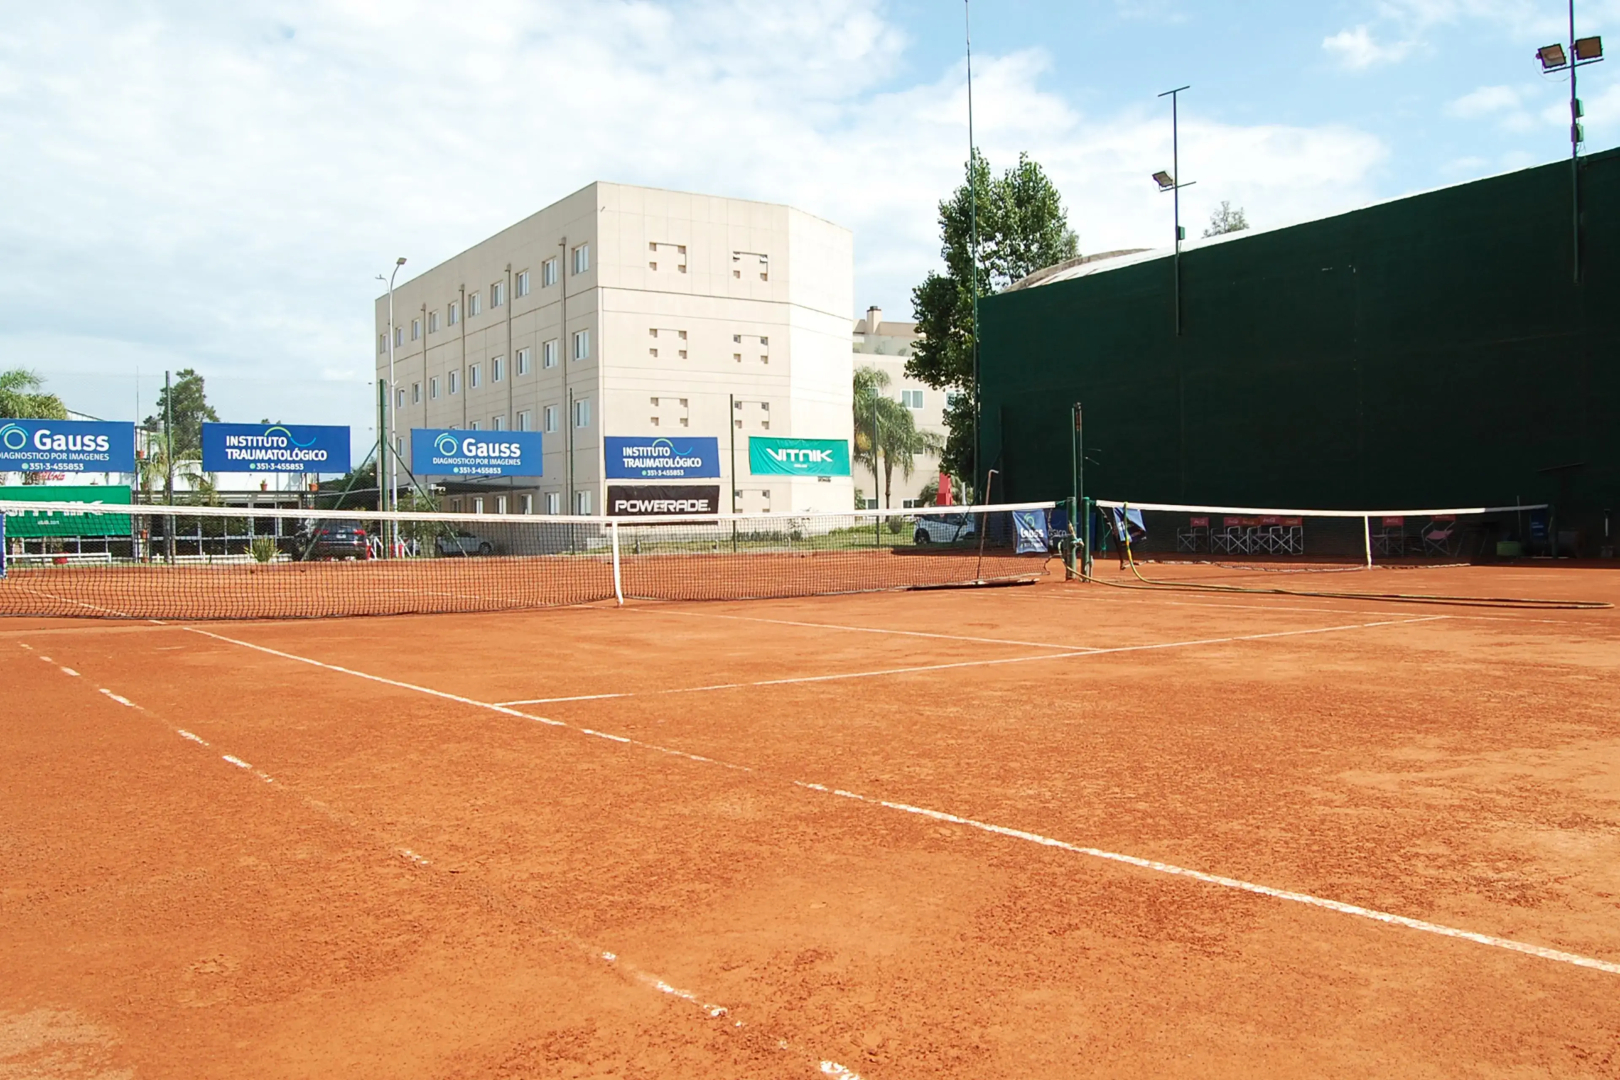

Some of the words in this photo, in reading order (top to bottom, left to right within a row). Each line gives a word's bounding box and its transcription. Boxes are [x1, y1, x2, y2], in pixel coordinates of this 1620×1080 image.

[34, 429, 110, 452] Gauss
[226, 435, 287, 448] INSTITUTO
[225, 447, 328, 461] TRAUMATOLÓGICO
[462, 438, 521, 458] Gauss
[622, 446, 671, 457] INSTITUTO
[51, 452, 67, 460] POR
[69, 453, 110, 461] IMAGENES
[432, 457, 475, 465] DIAGNOSTICO
[490, 458, 522, 466] IMAGENES
[766, 448, 833, 462] VITNIK
[622, 456, 702, 468] TRAUMATOLÓGICO
